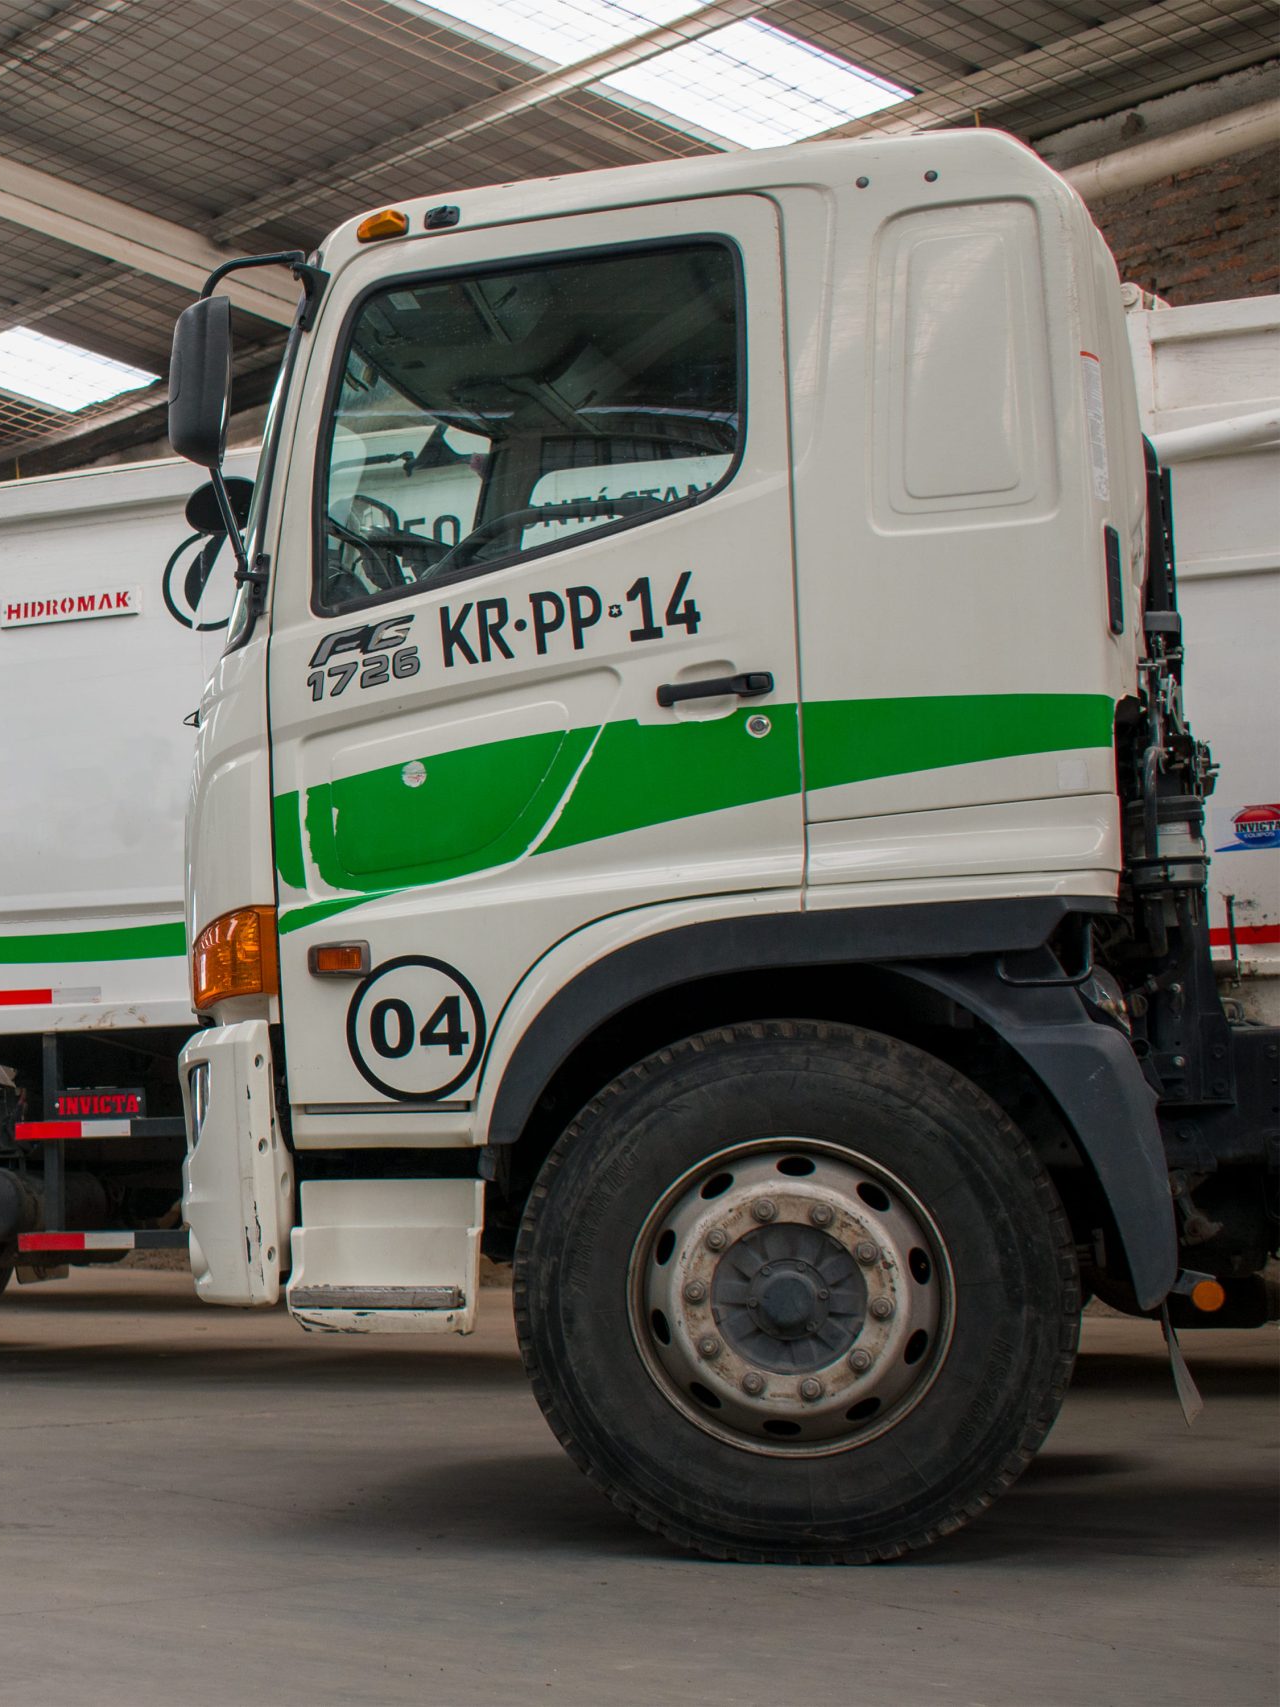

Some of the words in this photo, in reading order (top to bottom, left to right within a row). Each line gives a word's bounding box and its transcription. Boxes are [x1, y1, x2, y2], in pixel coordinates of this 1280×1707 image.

[7, 591, 129, 620] HIDROMAK
[307, 646, 421, 702] 1726
[370, 995, 470, 1059] 04
[58, 1094, 139, 1115] INVICTA
